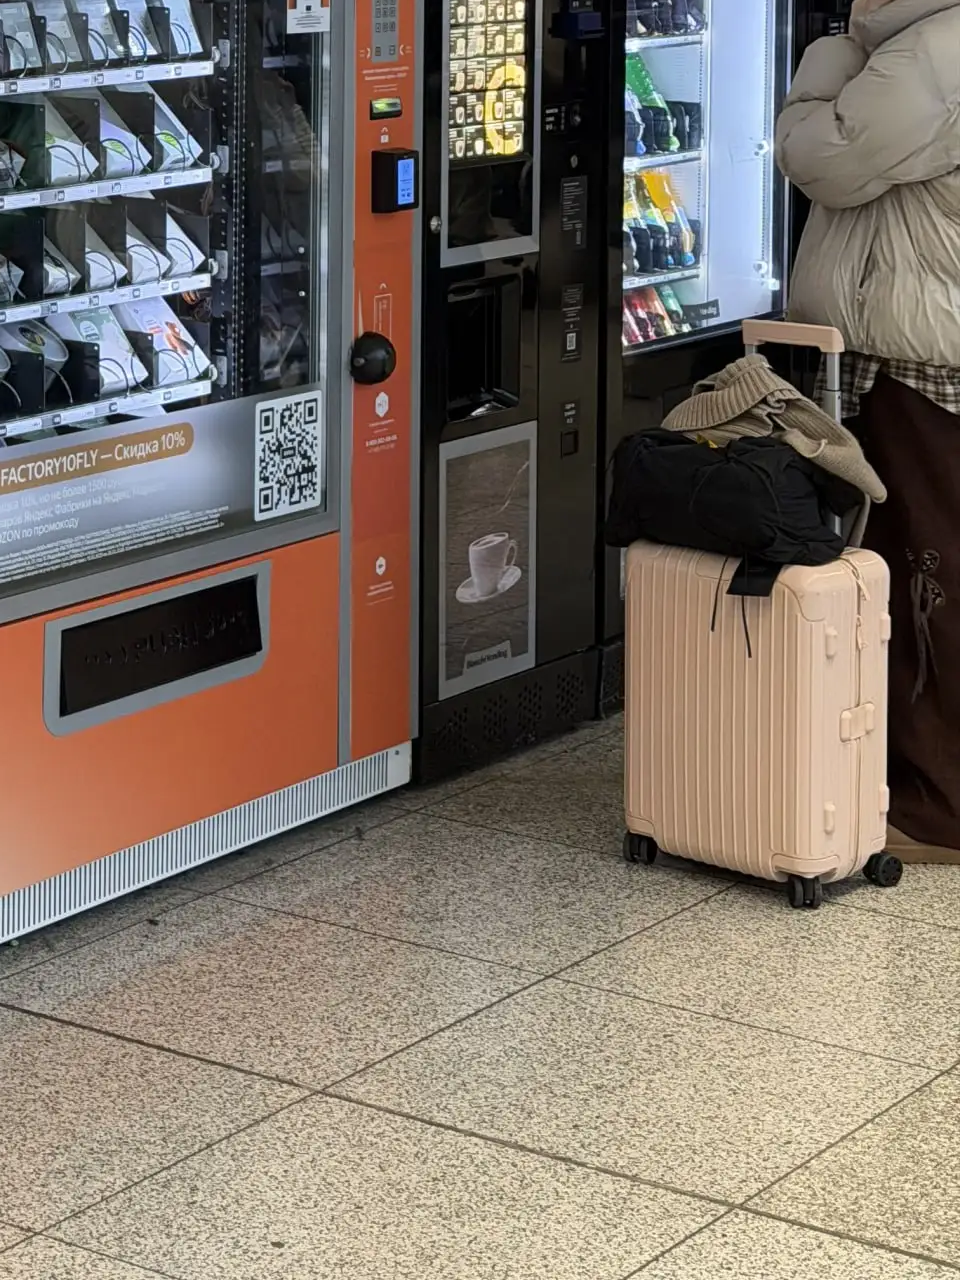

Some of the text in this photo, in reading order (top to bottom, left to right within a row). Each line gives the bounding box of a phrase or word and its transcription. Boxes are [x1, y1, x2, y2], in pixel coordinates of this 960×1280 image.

[0, 449, 99, 487] FACTORY10FLY
[114, 439, 159, 461] Скидка
[161, 430, 186, 451] 10%
[22, 527, 33, 540] по
[34, 517, 80, 536] промокоду
